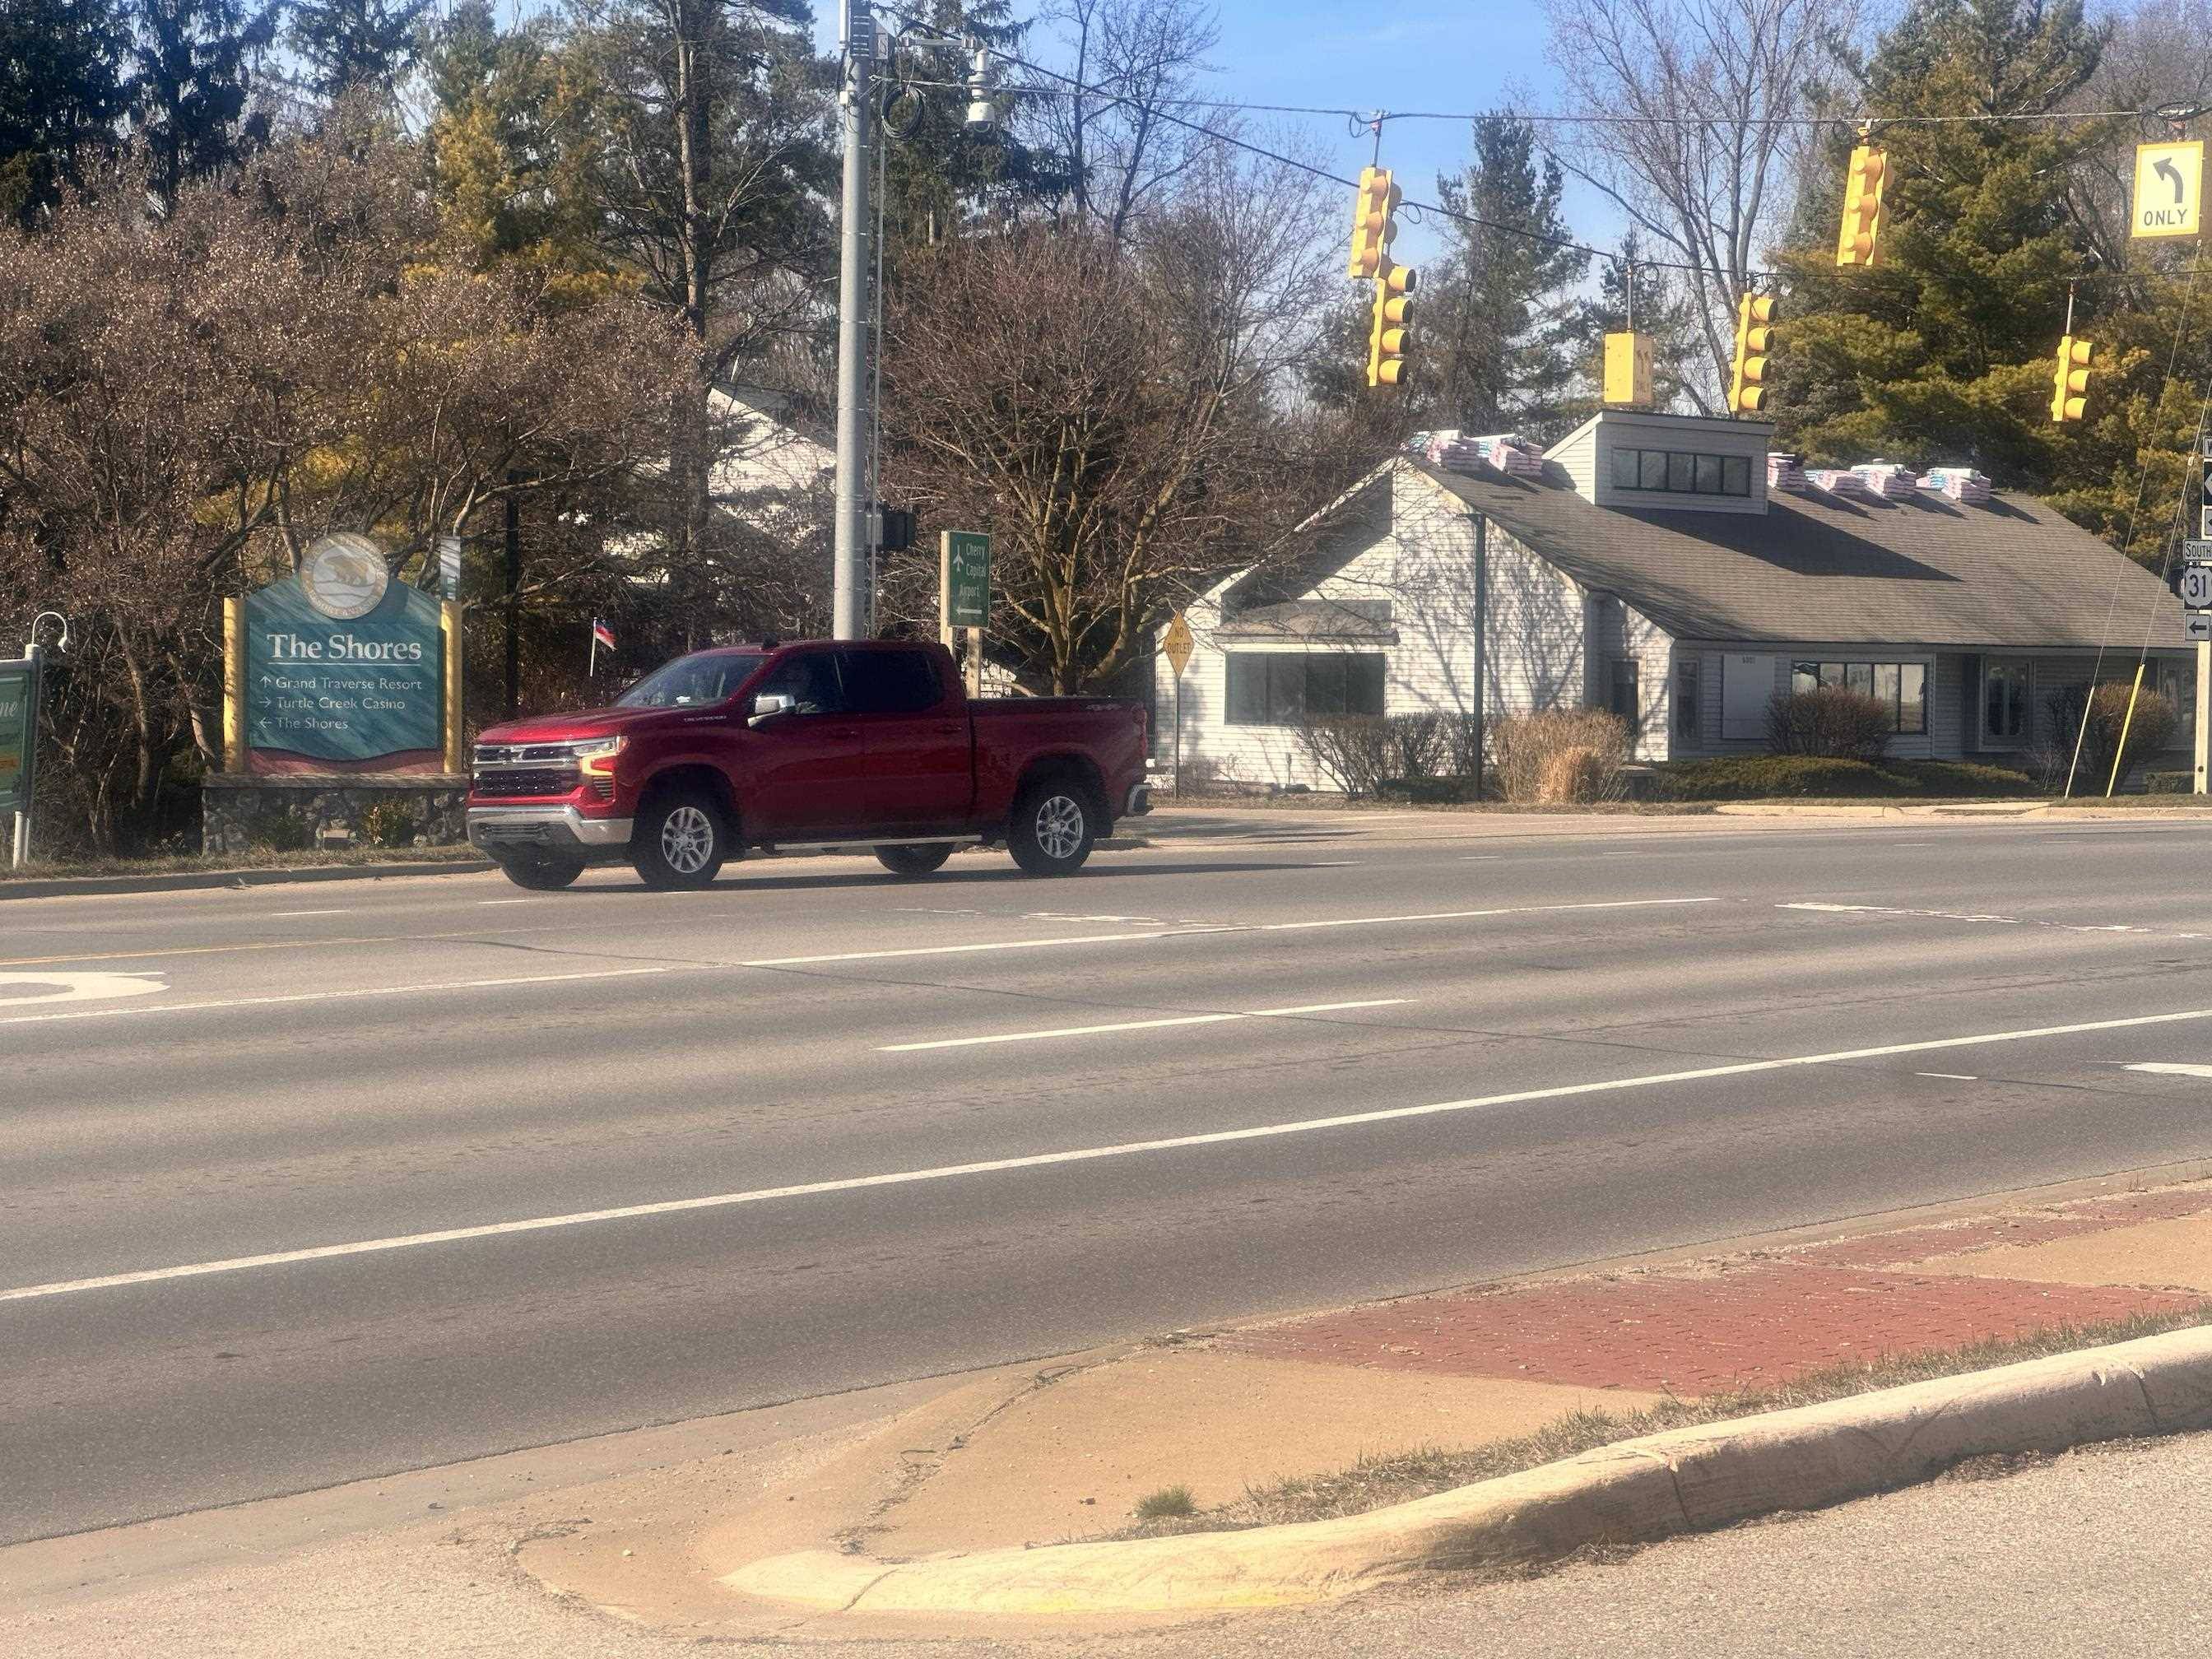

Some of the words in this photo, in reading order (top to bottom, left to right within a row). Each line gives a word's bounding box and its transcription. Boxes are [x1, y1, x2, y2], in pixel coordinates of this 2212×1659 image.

[2144, 208, 2187, 226] ONLY
[965, 541, 986, 560] Cherry
[2186, 543, 2212, 558] SOUTH
[959, 583, 980, 599] Airport
[2189, 574, 2206, 597] 31
[1175, 626, 1183, 638] NO
[267, 634, 323, 659] The
[329, 633, 422, 660] Shores
[1168, 642, 1191, 654] OUTLET
[276, 677, 316, 690] Grand
[323, 677, 375, 690] Traverse
[379, 678, 422, 690] Resort
[276, 697, 314, 709] Turtle
[318, 697, 358, 709] Creek
[362, 698, 406, 709] Casino
[276, 717, 304, 729] The
[305, 718, 349, 730] Shores
